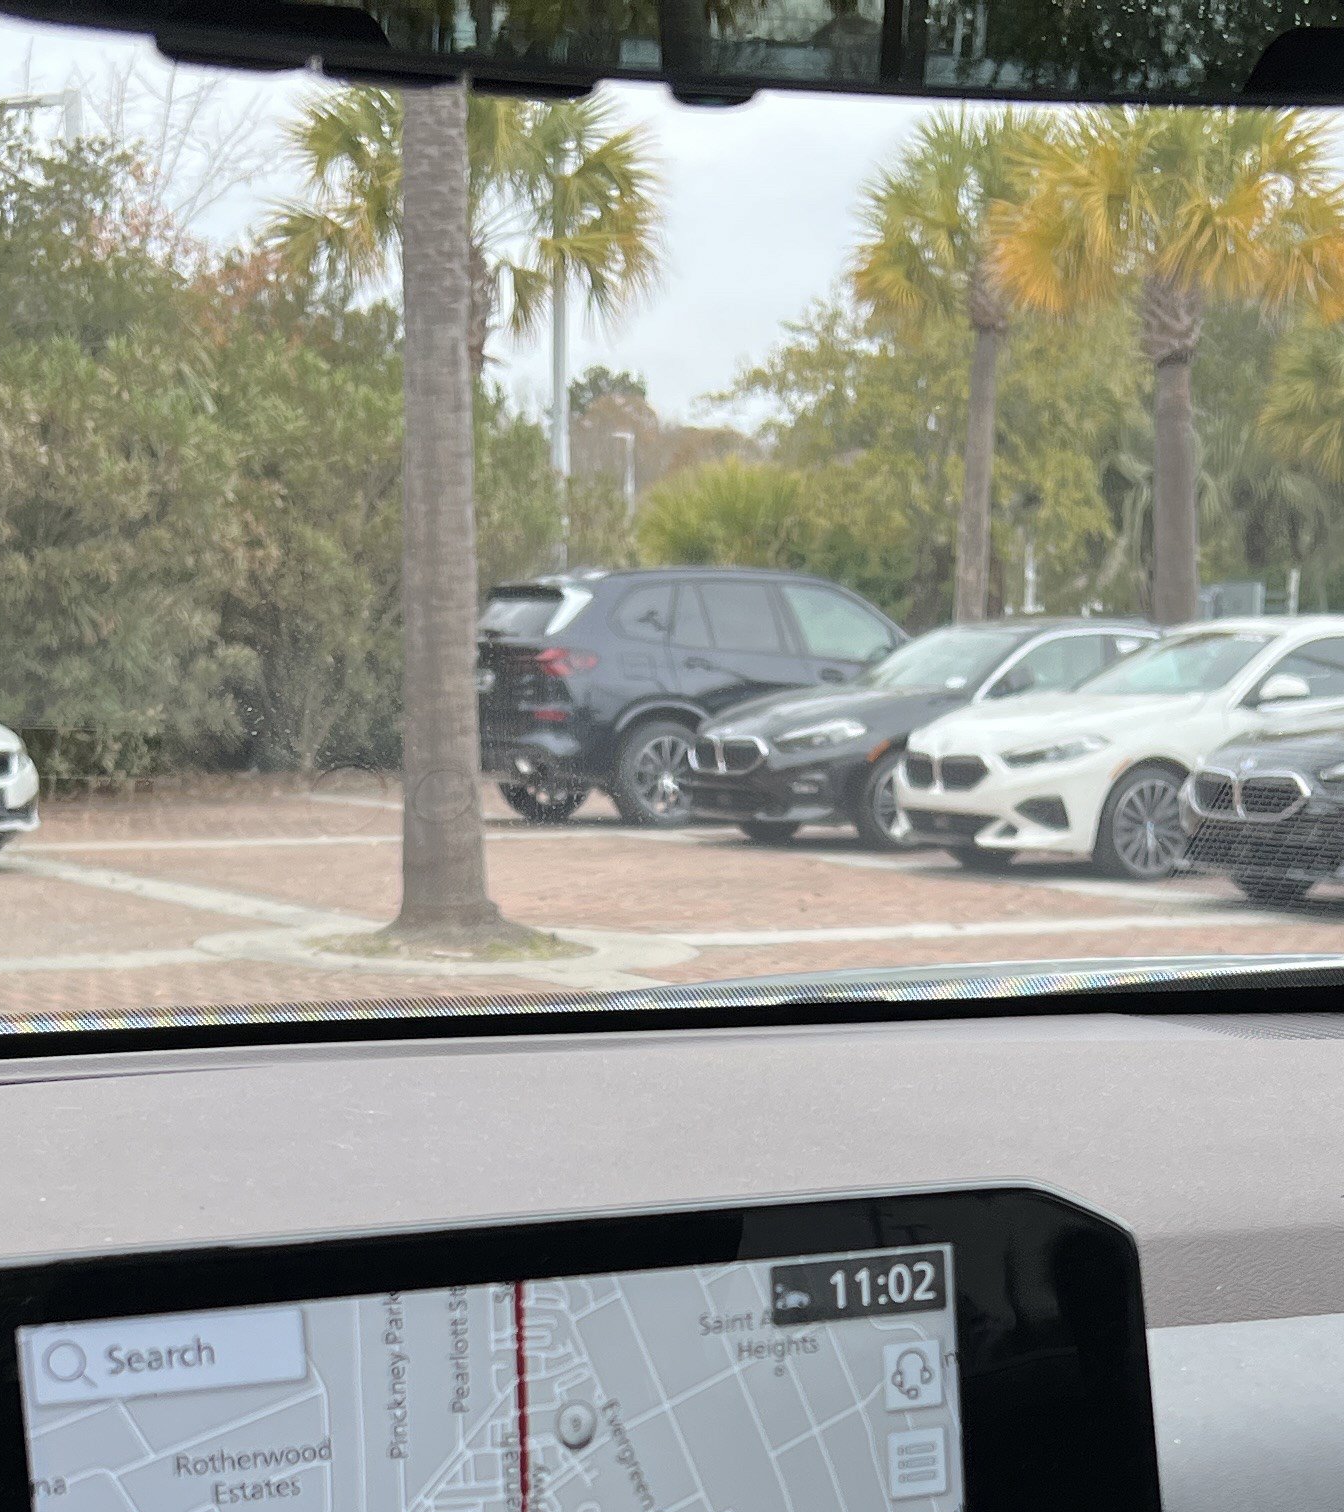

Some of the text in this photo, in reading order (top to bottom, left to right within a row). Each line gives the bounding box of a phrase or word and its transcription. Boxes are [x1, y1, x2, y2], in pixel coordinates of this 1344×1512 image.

[829, 1260, 938, 1310] 11:02
[698, 1310, 754, 1338] Saint
[106, 1335, 216, 1375] Search
[450, 1316, 471, 1414] Pearlott
[736, 1333, 820, 1366] Heights
[388, 1351, 410, 1460] Pinckney
[175, 1438, 333, 1478] Rotherwood
[214, 1475, 302, 1505] Estates
